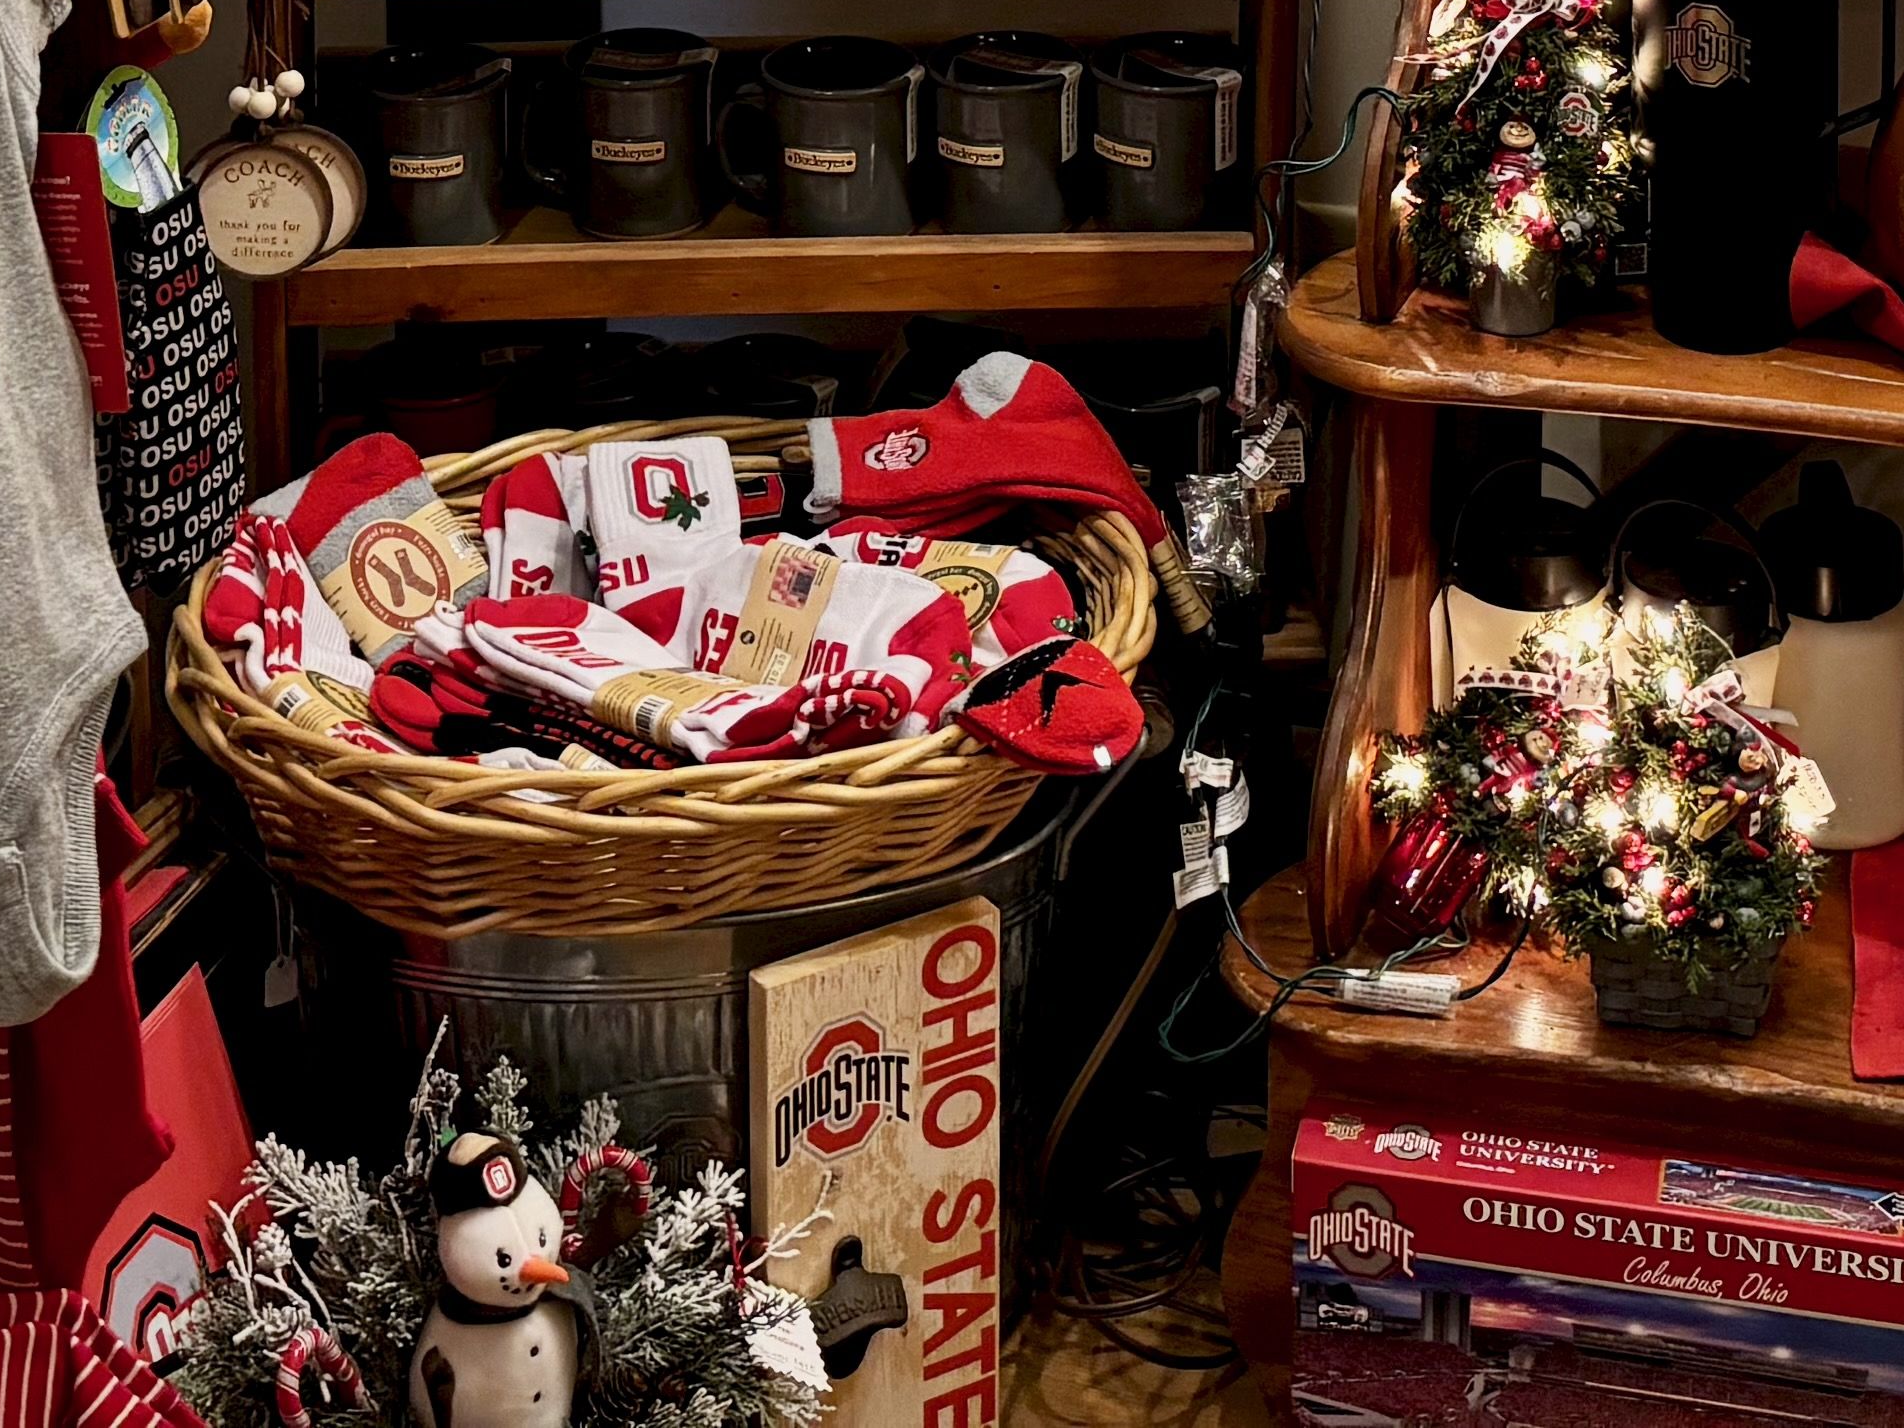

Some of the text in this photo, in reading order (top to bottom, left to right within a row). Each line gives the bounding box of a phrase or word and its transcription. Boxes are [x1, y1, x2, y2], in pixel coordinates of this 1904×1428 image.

[599, 143, 659, 162] Buckeyes
[224, 158, 305, 187] COACH
[151, 202, 194, 246] OSU
[218, 218, 301, 236] thank you for
[230, 245, 295, 259] difference
[163, 322, 206, 367] OSU
[169, 444, 213, 488] OSU
[920, 922, 998, 1150] OHIO
[1457, 1144, 1606, 1176] UNIVERSITY
[1461, 1130, 1600, 1161] OHIO STATE
[1461, 1195, 1566, 1234] OHIO
[1572, 1211, 1698, 1255] STATE
[1622, 1255, 1791, 1305] Columbus, Ohio
